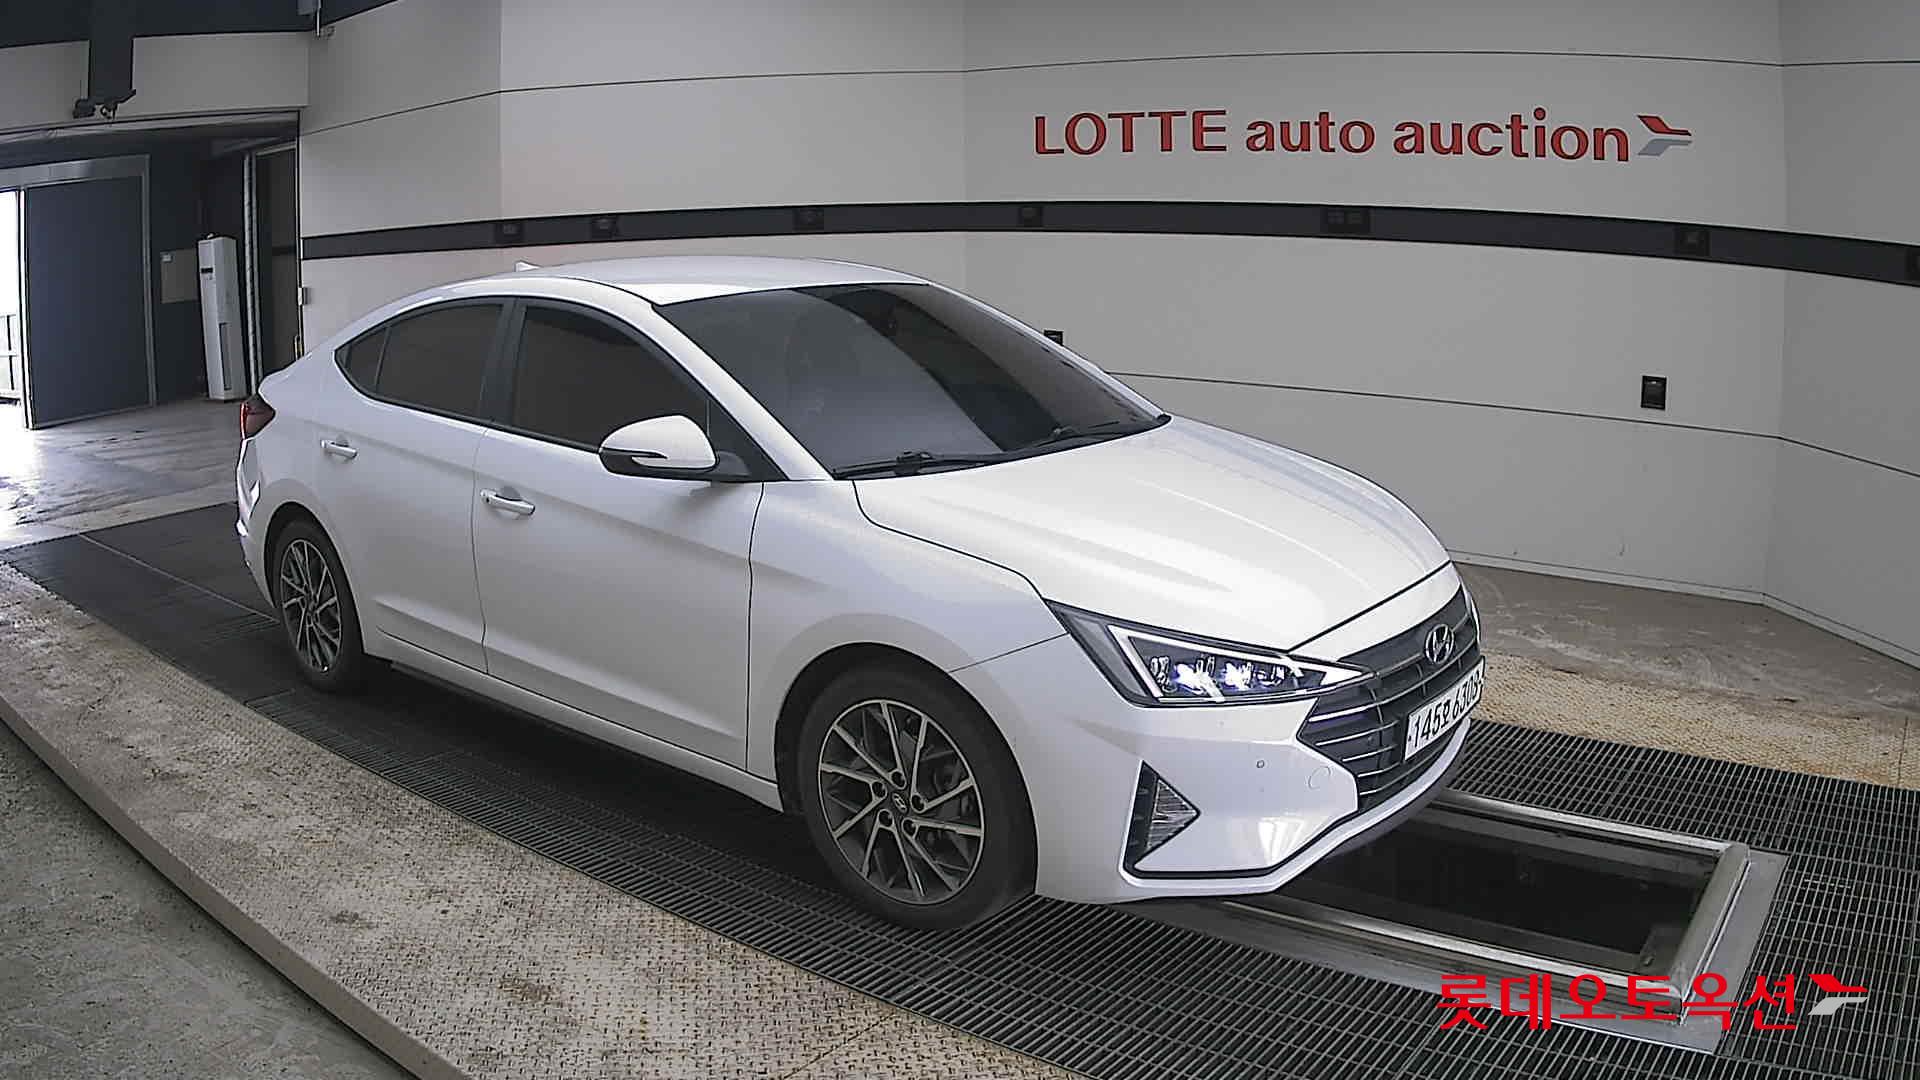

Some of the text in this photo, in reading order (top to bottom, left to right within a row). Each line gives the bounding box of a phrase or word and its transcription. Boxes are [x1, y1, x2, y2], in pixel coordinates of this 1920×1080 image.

[1034, 107, 1630, 162] LOTTE auto auction
